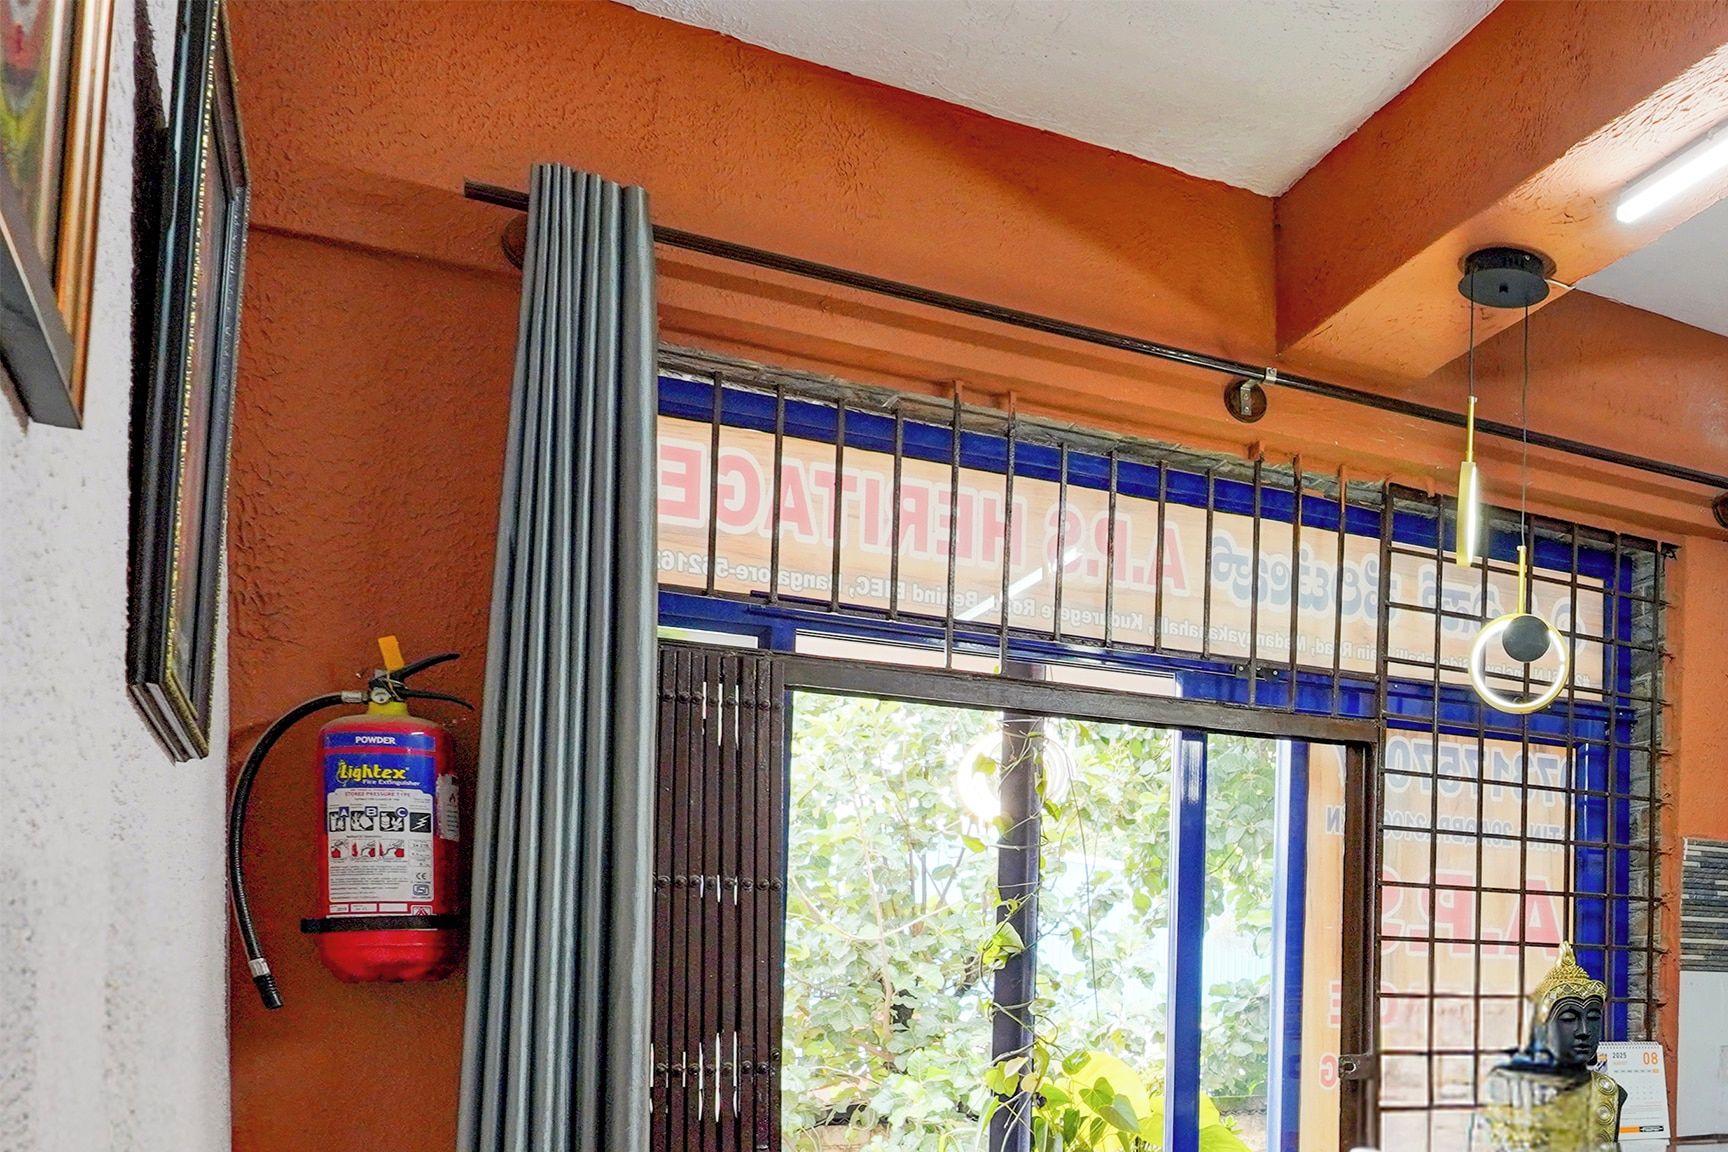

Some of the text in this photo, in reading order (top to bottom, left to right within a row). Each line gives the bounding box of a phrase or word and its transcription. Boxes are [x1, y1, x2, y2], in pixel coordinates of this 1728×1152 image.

[355, 735, 397, 745] POWDER
[338, 760, 407, 782] Lightex
[1612, 1051, 1659, 1065] 2025 08
